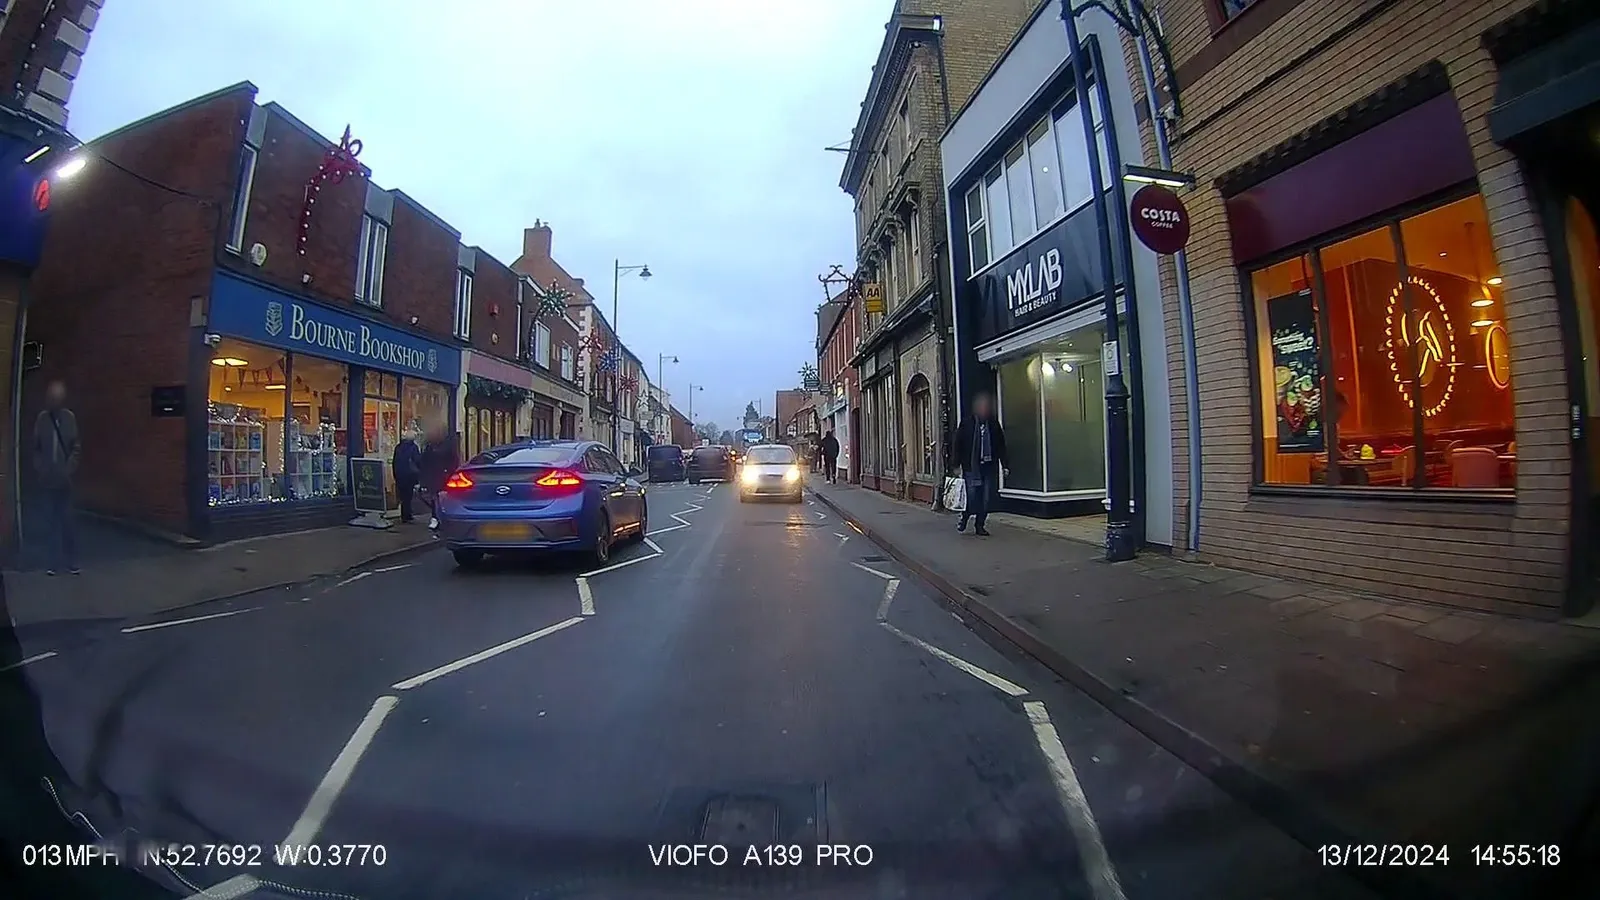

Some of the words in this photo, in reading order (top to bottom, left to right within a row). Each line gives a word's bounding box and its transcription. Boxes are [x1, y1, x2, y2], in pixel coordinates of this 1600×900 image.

[1141, 207, 1180, 222] COSTA
[867, 287, 880, 298] AA
[1015, 304, 1028, 317] HAIR
[1033, 291, 1056, 309] BEAUTY
[289, 304, 356, 353] BOURNE
[359, 325, 425, 370] BOOKSHOP
